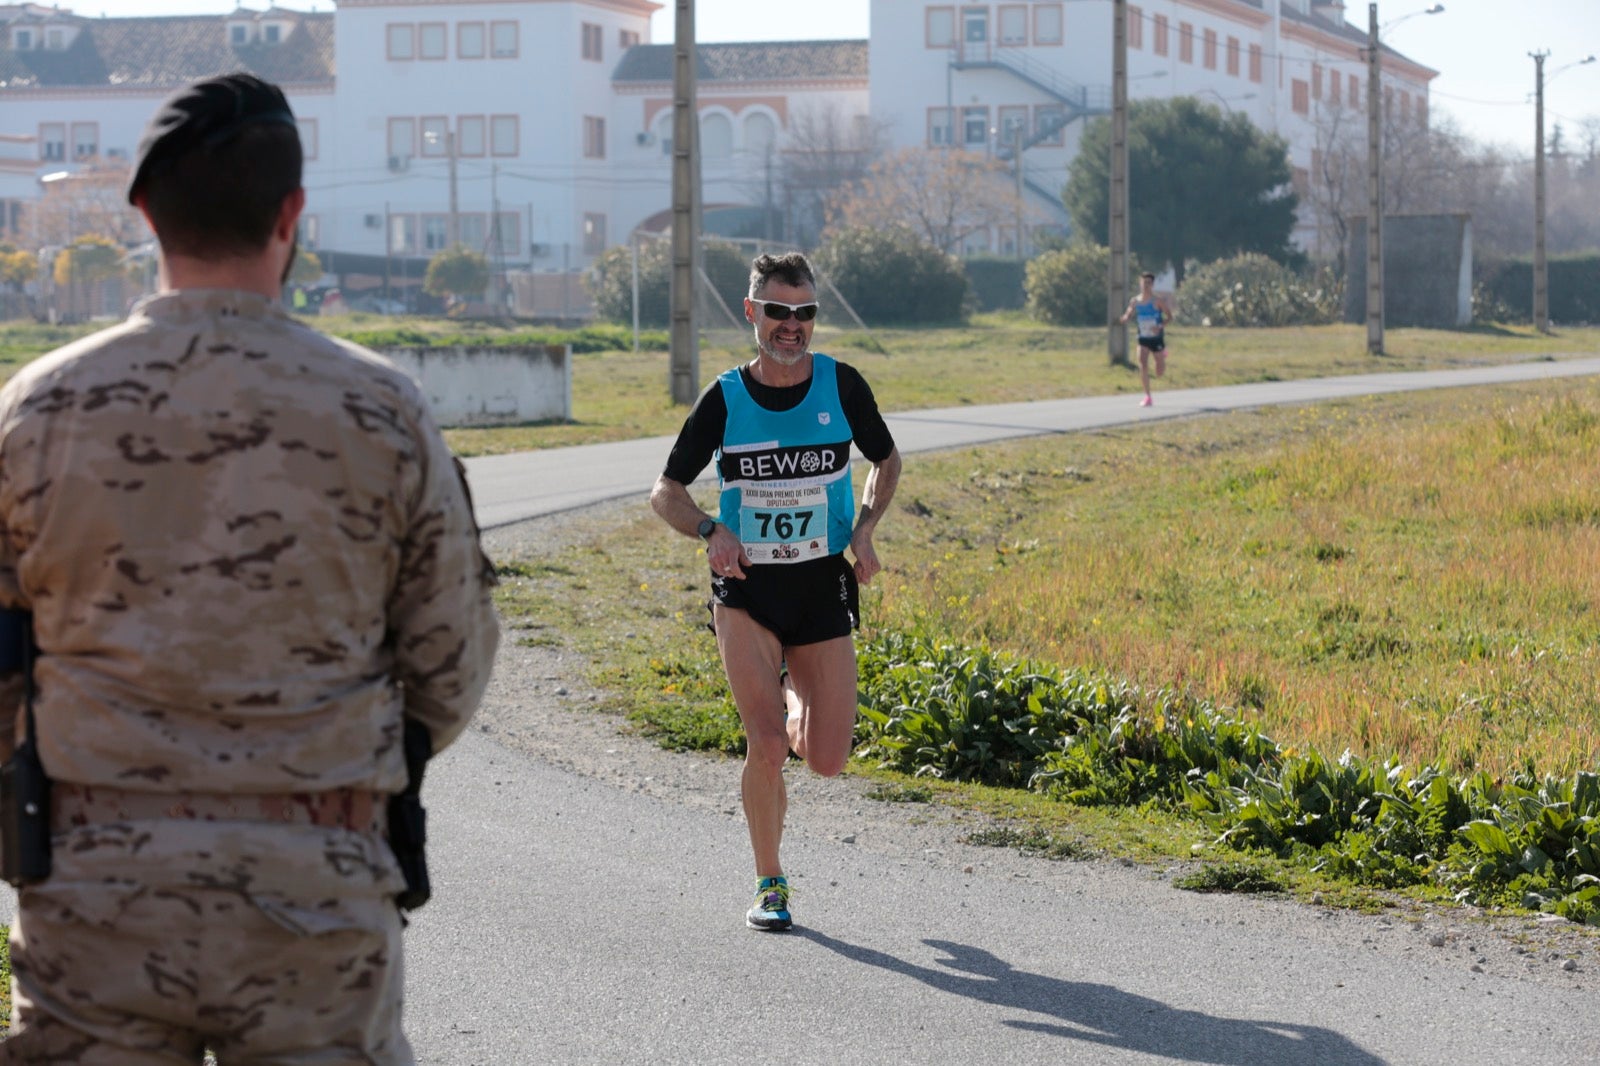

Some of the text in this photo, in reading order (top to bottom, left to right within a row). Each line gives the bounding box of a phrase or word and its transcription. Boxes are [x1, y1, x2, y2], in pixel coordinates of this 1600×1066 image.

[760, 489, 773, 499] GRAN
[774, 489, 795, 499] PREMIO
[796, 488, 803, 498] DE
[804, 486, 821, 497] FONDO
[754, 510, 814, 540] 767
